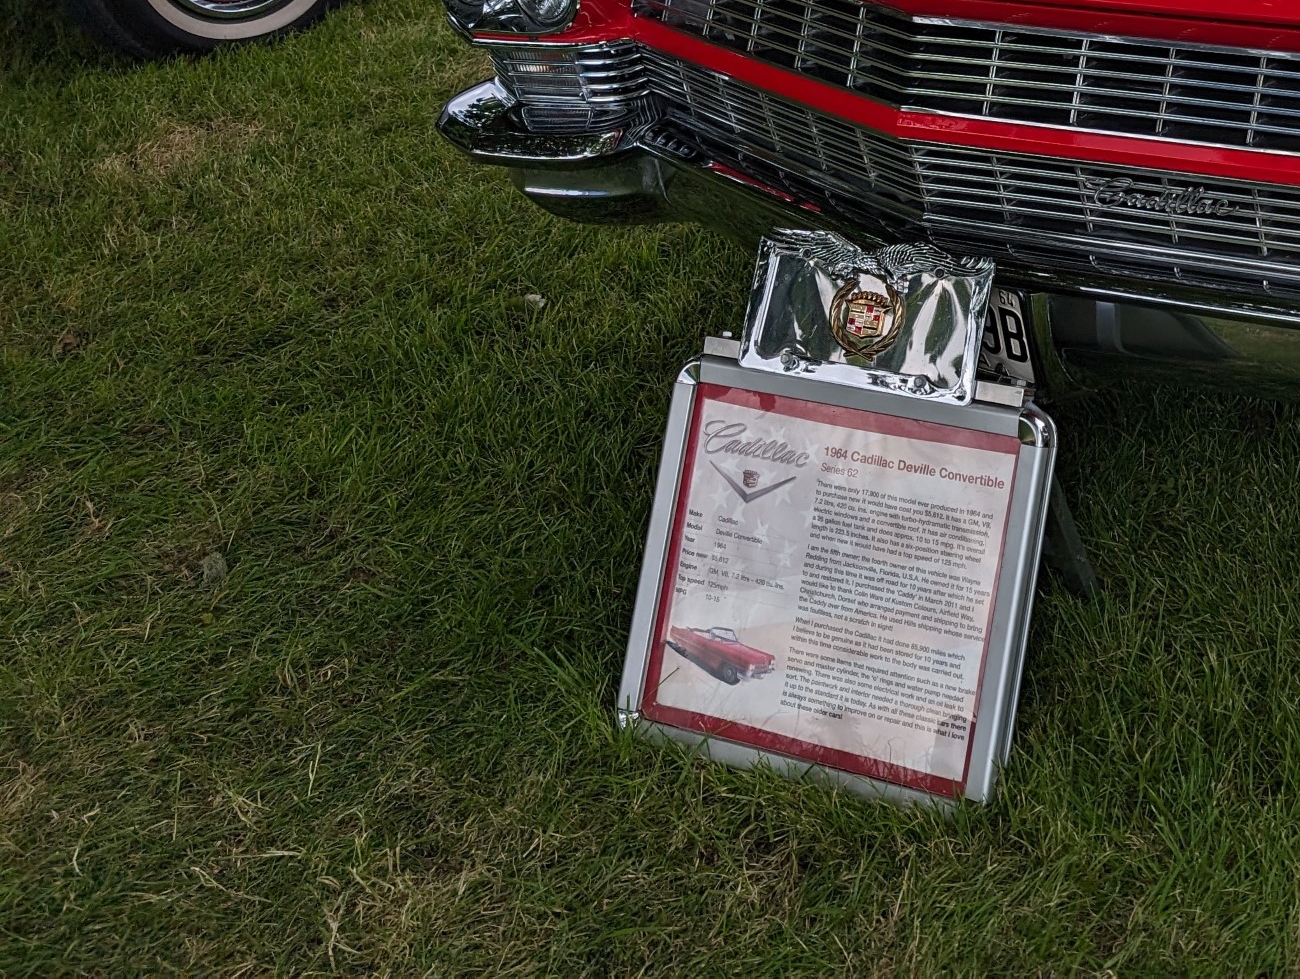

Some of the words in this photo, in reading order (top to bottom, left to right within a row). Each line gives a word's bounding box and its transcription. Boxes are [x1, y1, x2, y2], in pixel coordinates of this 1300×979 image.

[1084, 177, 1239, 216] Cadillac
[998, 290, 1016, 307] 64
[702, 420, 810, 468] Cadillac
[820, 462, 845, 476] Series
[846, 468, 858, 478] 62
[824, 446, 848, 460] 1964
[850, 451, 894, 469] Cadillac
[897, 460, 936, 476] Deville
[939, 468, 1004, 489] Convertible
[833, 510, 858, 519] windows
[930, 502, 958, 514] produced
[689, 509, 703, 517] Make
[718, 516, 738, 525] Cadillac
[687, 522, 702, 530] Model
[716, 528, 732, 537] Deville
[734, 532, 762, 544] Convertible
[682, 548, 695, 556] Price
[680, 561, 697, 570] Engine
[687, 577, 705, 586] speed
[708, 581, 728, 591] 125mph
[676, 587, 687, 595] MPG
[706, 594, 720, 602] 10-15
[854, 581, 884, 593] purchased
[924, 596, 943, 605] March
[891, 598, 912, 607] Kustom
[933, 616, 958, 628] shipping
[902, 660, 916, 669] body
